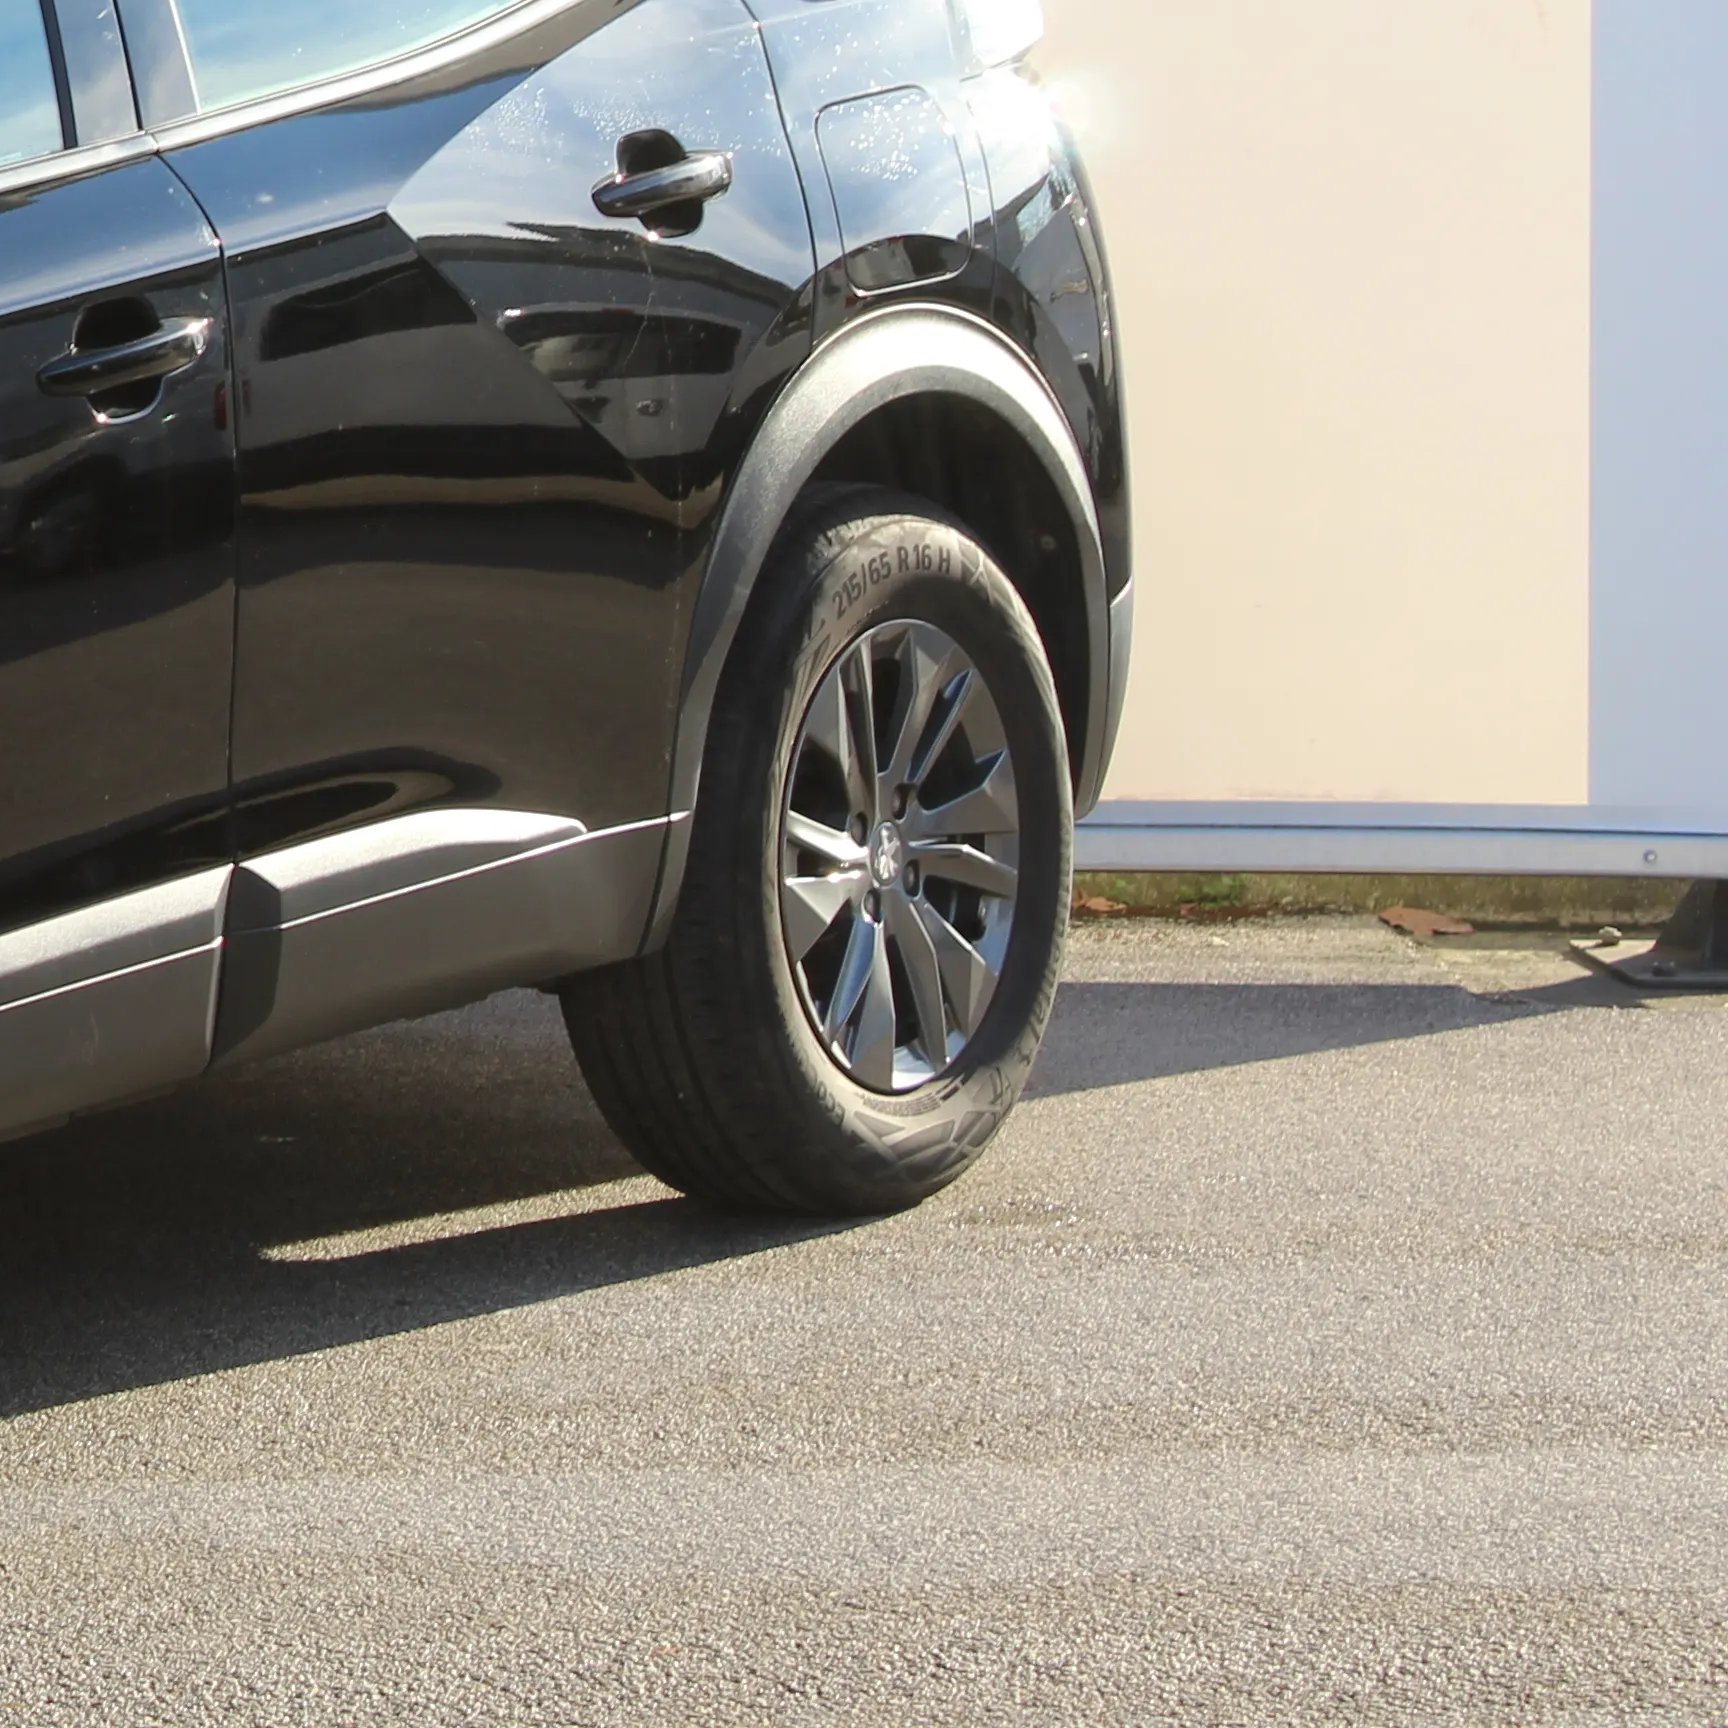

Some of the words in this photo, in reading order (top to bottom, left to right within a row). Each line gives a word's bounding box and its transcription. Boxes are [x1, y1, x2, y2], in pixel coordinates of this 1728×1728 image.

[832, 551, 891, 620] 215/65
[897, 545, 910, 573] R
[913, 543, 932, 571] 16
[938, 546, 951, 574] H
